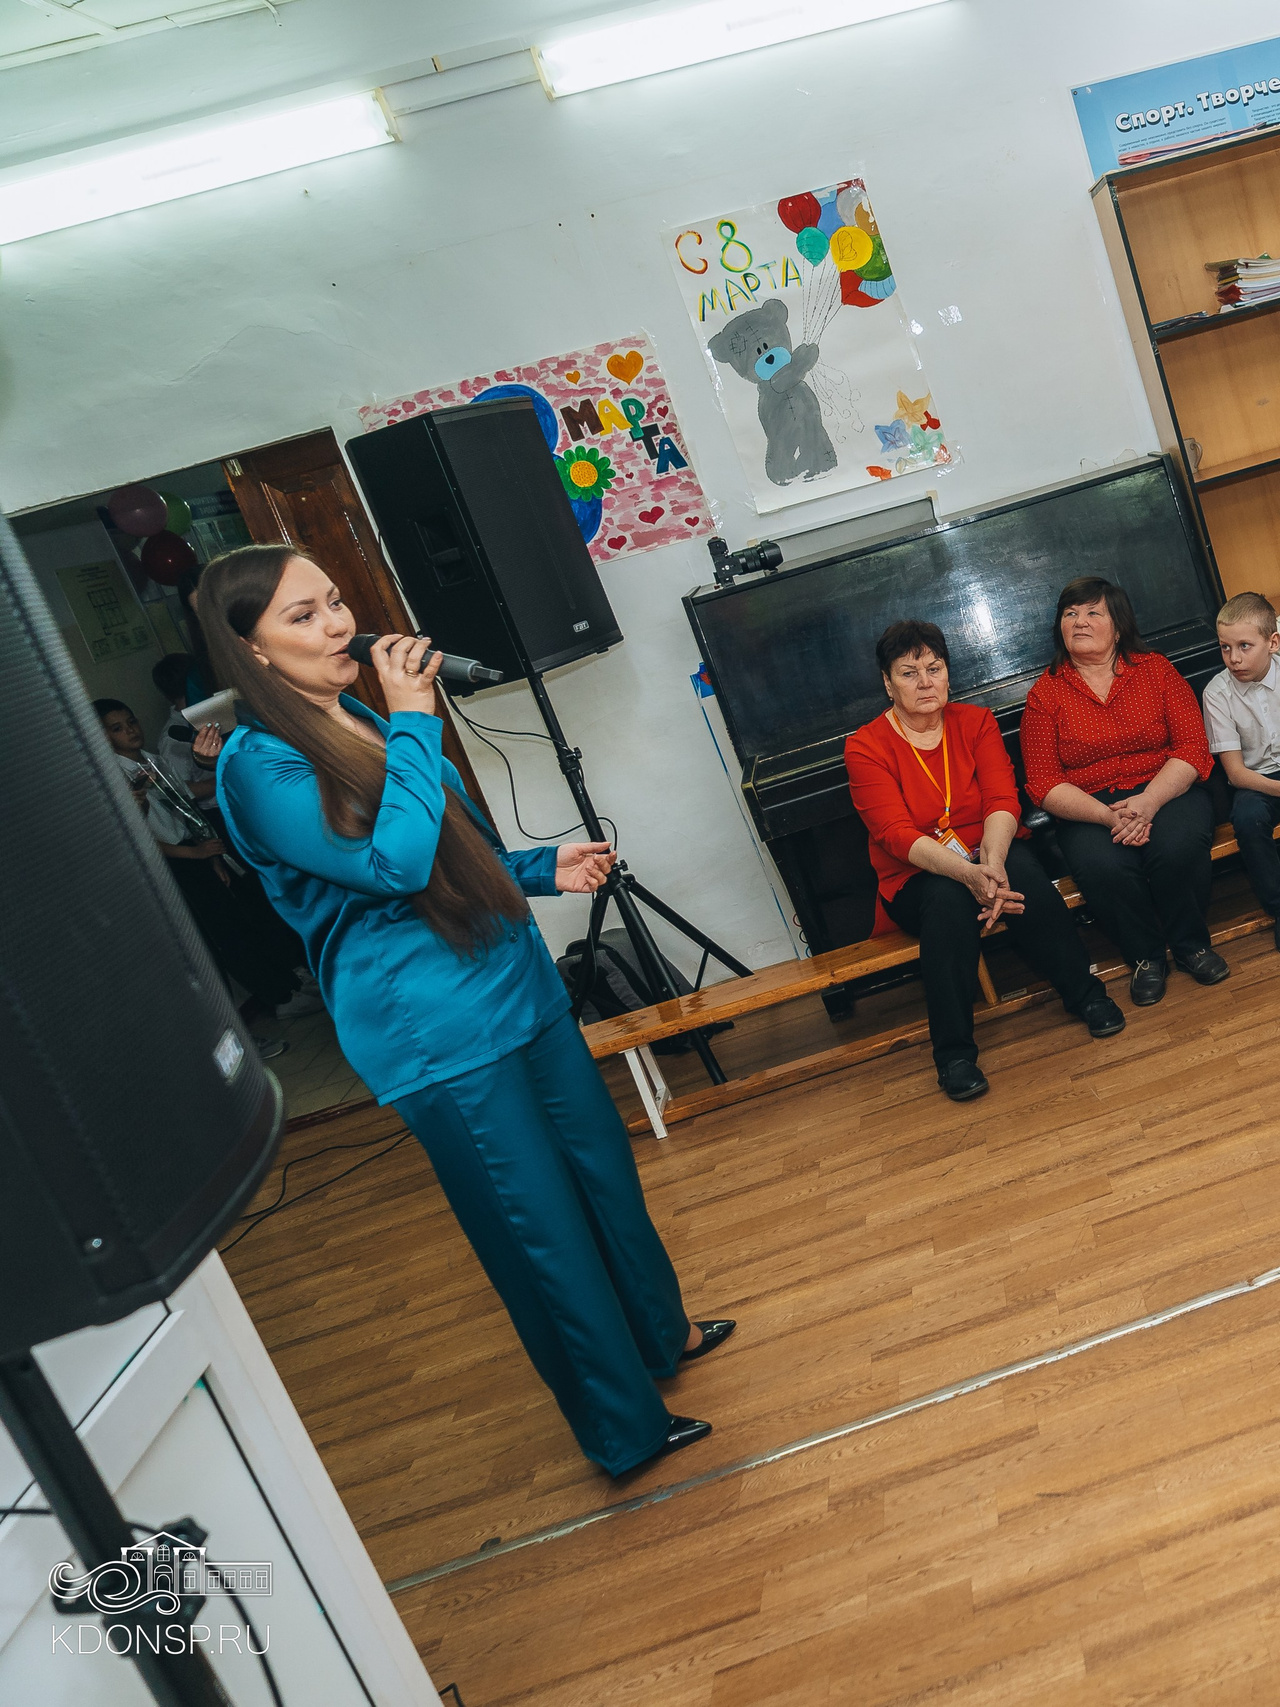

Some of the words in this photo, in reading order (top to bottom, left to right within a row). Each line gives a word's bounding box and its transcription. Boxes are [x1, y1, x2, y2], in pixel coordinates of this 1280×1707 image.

[1115, 101, 1194, 132] Спорт.
[675, 230, 708, 275] С
[716, 219, 753, 273] 8
[698, 256, 803, 322] МАРТА
[560, 398, 688, 475] МАРТА
